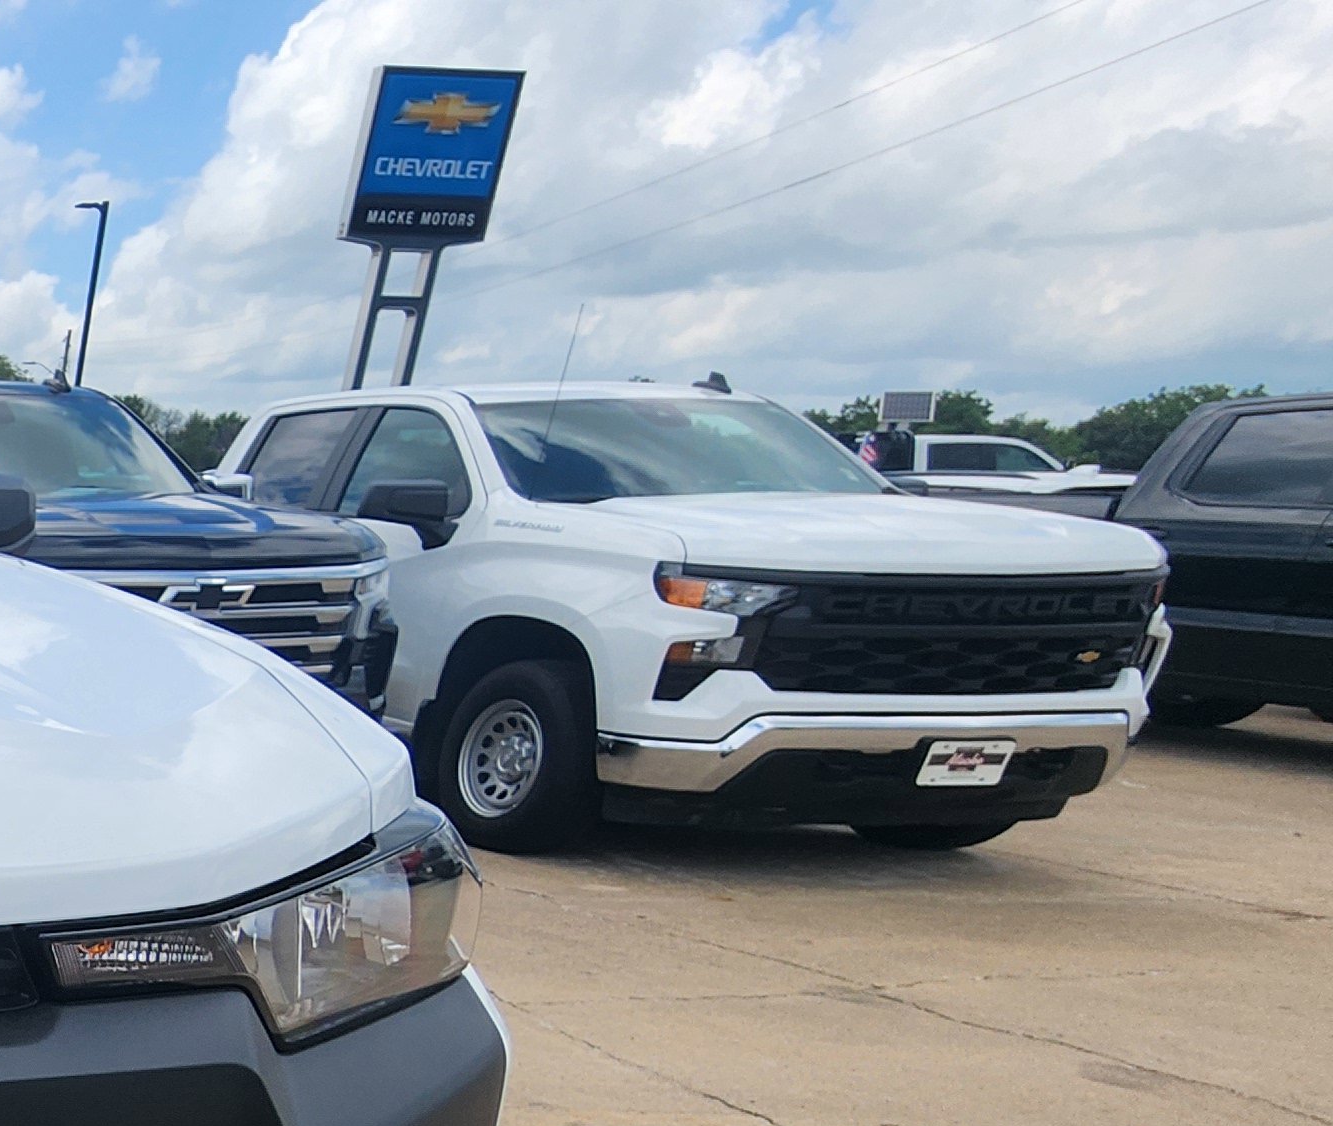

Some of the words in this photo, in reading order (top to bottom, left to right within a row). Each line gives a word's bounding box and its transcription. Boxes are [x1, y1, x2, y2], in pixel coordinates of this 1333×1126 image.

[374, 156, 493, 179] CHEVROLET
[366, 209, 415, 225] MACKE
[420, 211, 476, 227] MOTORS
